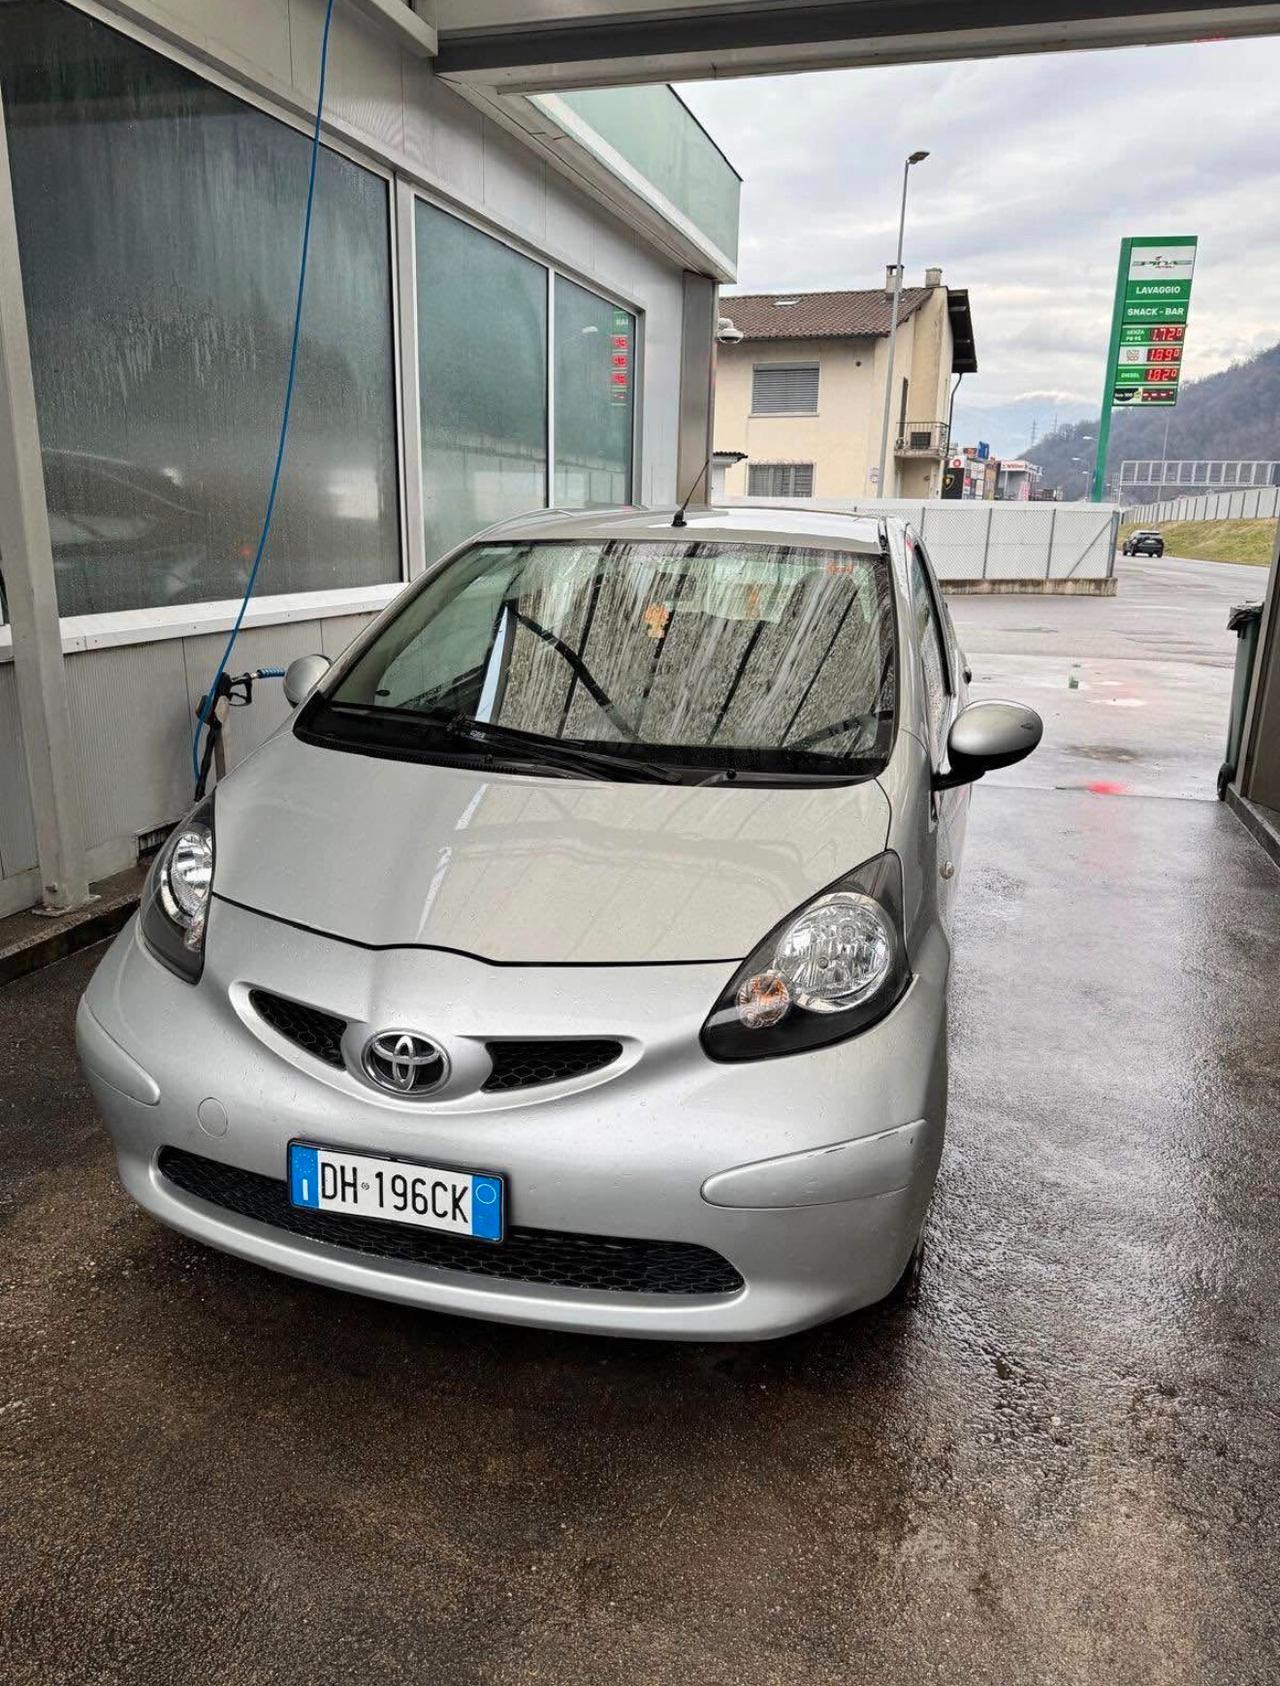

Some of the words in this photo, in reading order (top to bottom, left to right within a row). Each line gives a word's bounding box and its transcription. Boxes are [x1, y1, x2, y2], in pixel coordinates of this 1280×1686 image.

[1136, 286, 1181, 295] LAVAGGIO
[1127, 308, 1158, 316] SNACK
[1165, 307, 1184, 316] BAR
[320, 1161, 358, 1204] DH
[374, 1170, 470, 1223] 196CK
